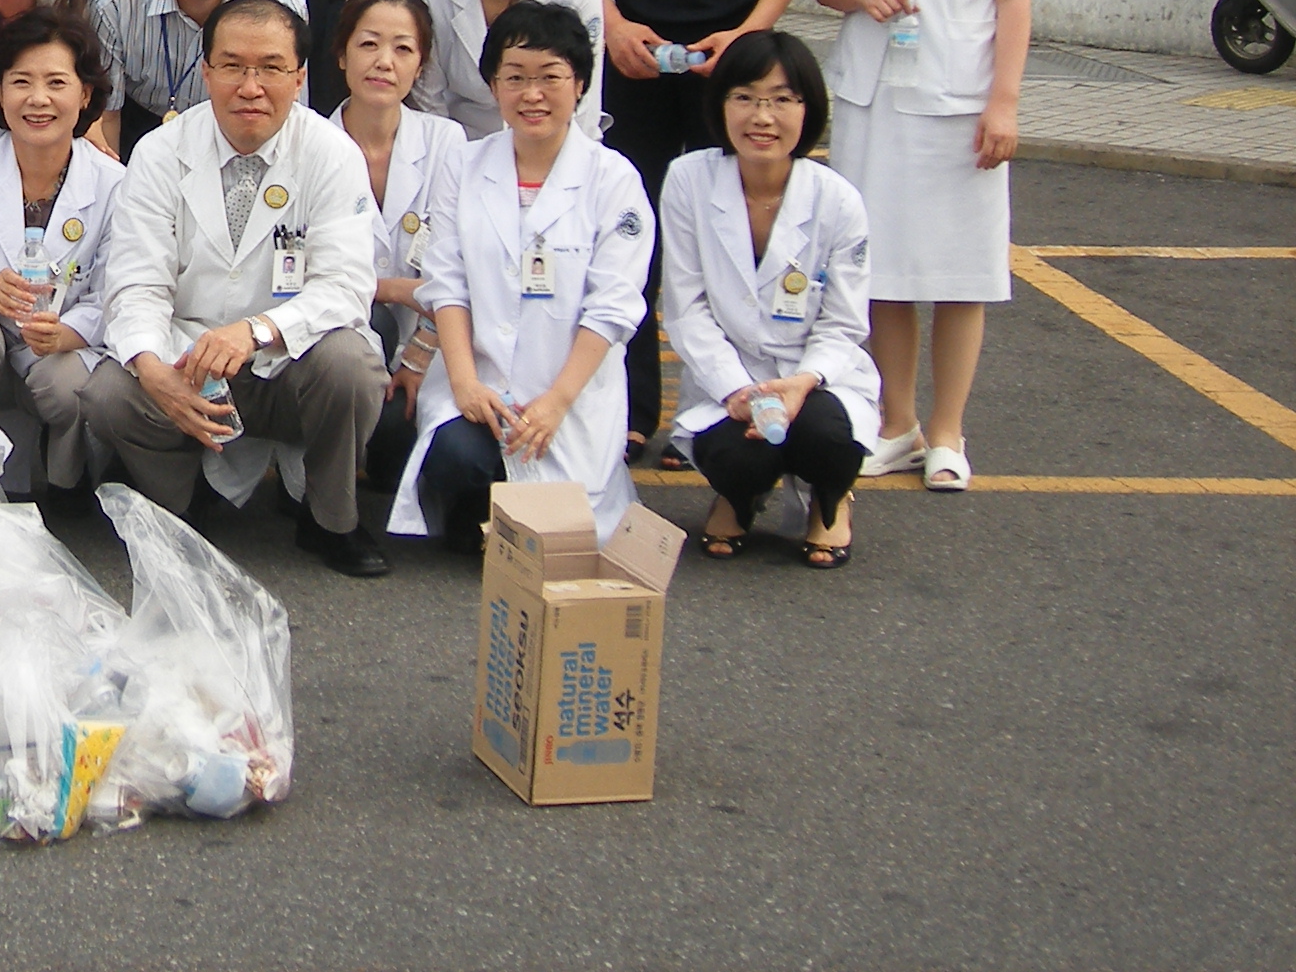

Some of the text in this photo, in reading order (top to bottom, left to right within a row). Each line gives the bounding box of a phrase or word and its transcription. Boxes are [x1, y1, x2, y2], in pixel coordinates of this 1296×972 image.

[486, 600, 500, 711] natural
[558, 651, 579, 737] natural
[575, 642, 597, 737] mineral
[594, 666, 613, 737] water
[613, 689, 636, 731] 석수
[544, 734, 553, 765] JINRO
